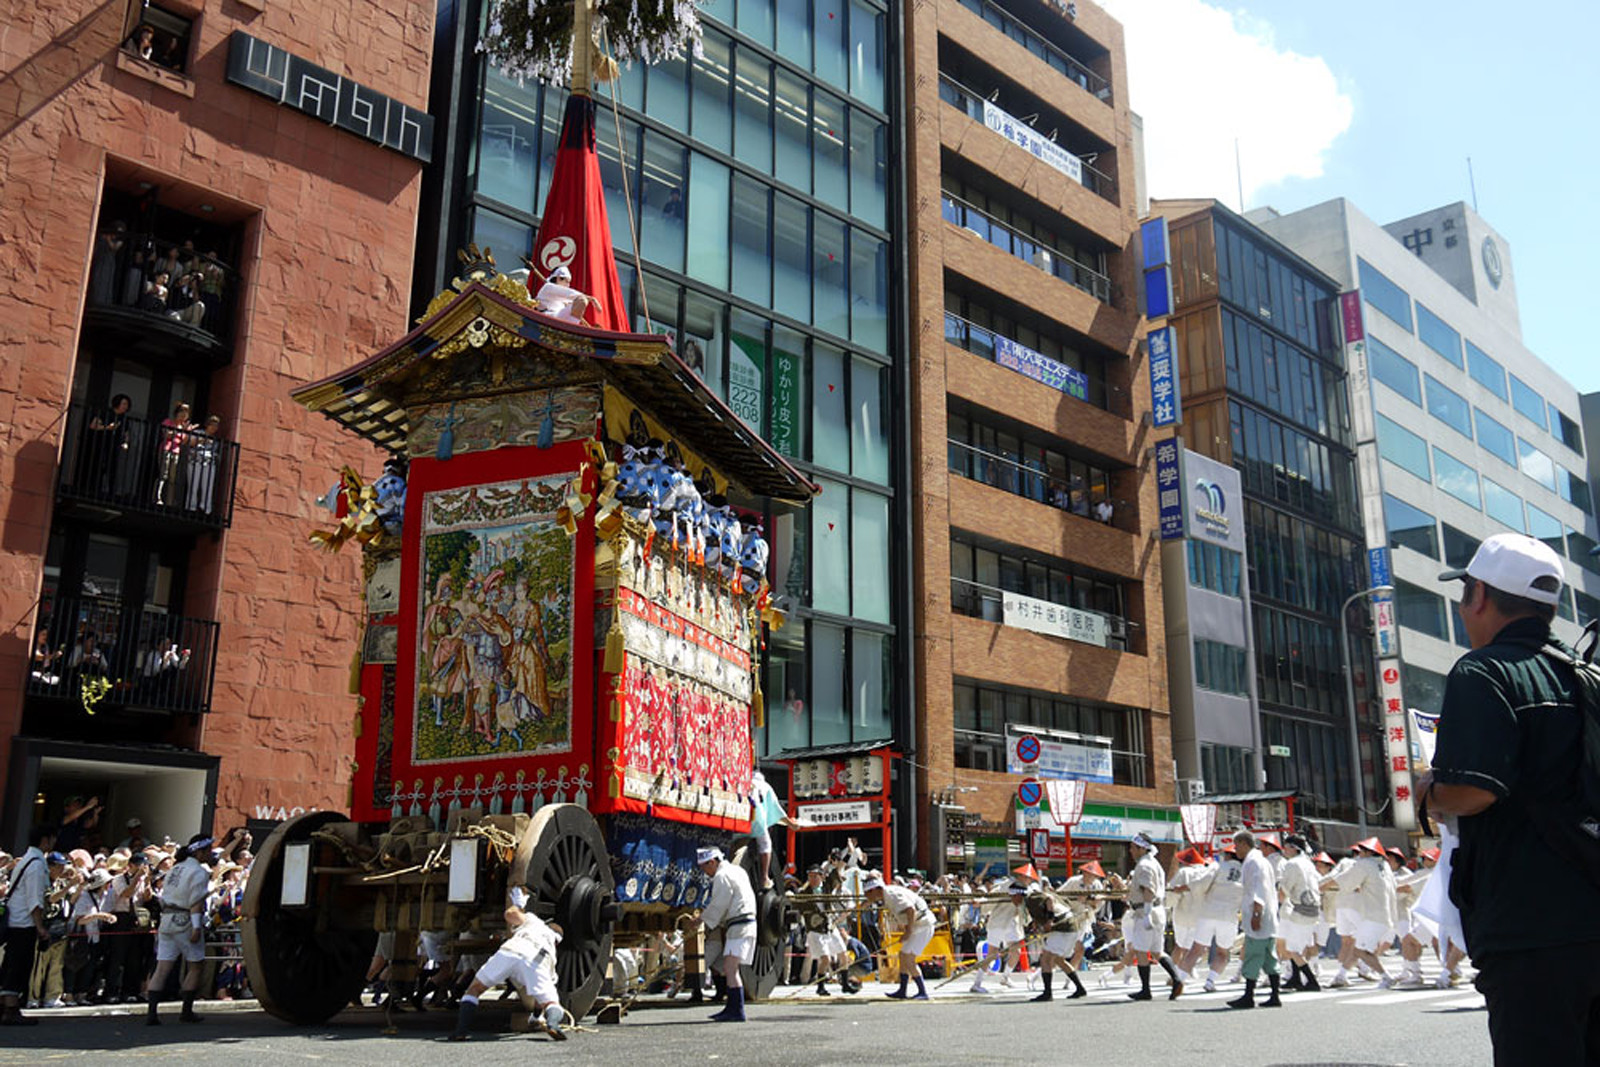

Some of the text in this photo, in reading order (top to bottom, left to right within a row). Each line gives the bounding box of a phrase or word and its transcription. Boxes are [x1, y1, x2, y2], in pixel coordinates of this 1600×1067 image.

[731, 386, 758, 408] 222
[1017, 601, 1095, 633] 村井歯科医院
[1386, 698, 1411, 801] 東洋証券
